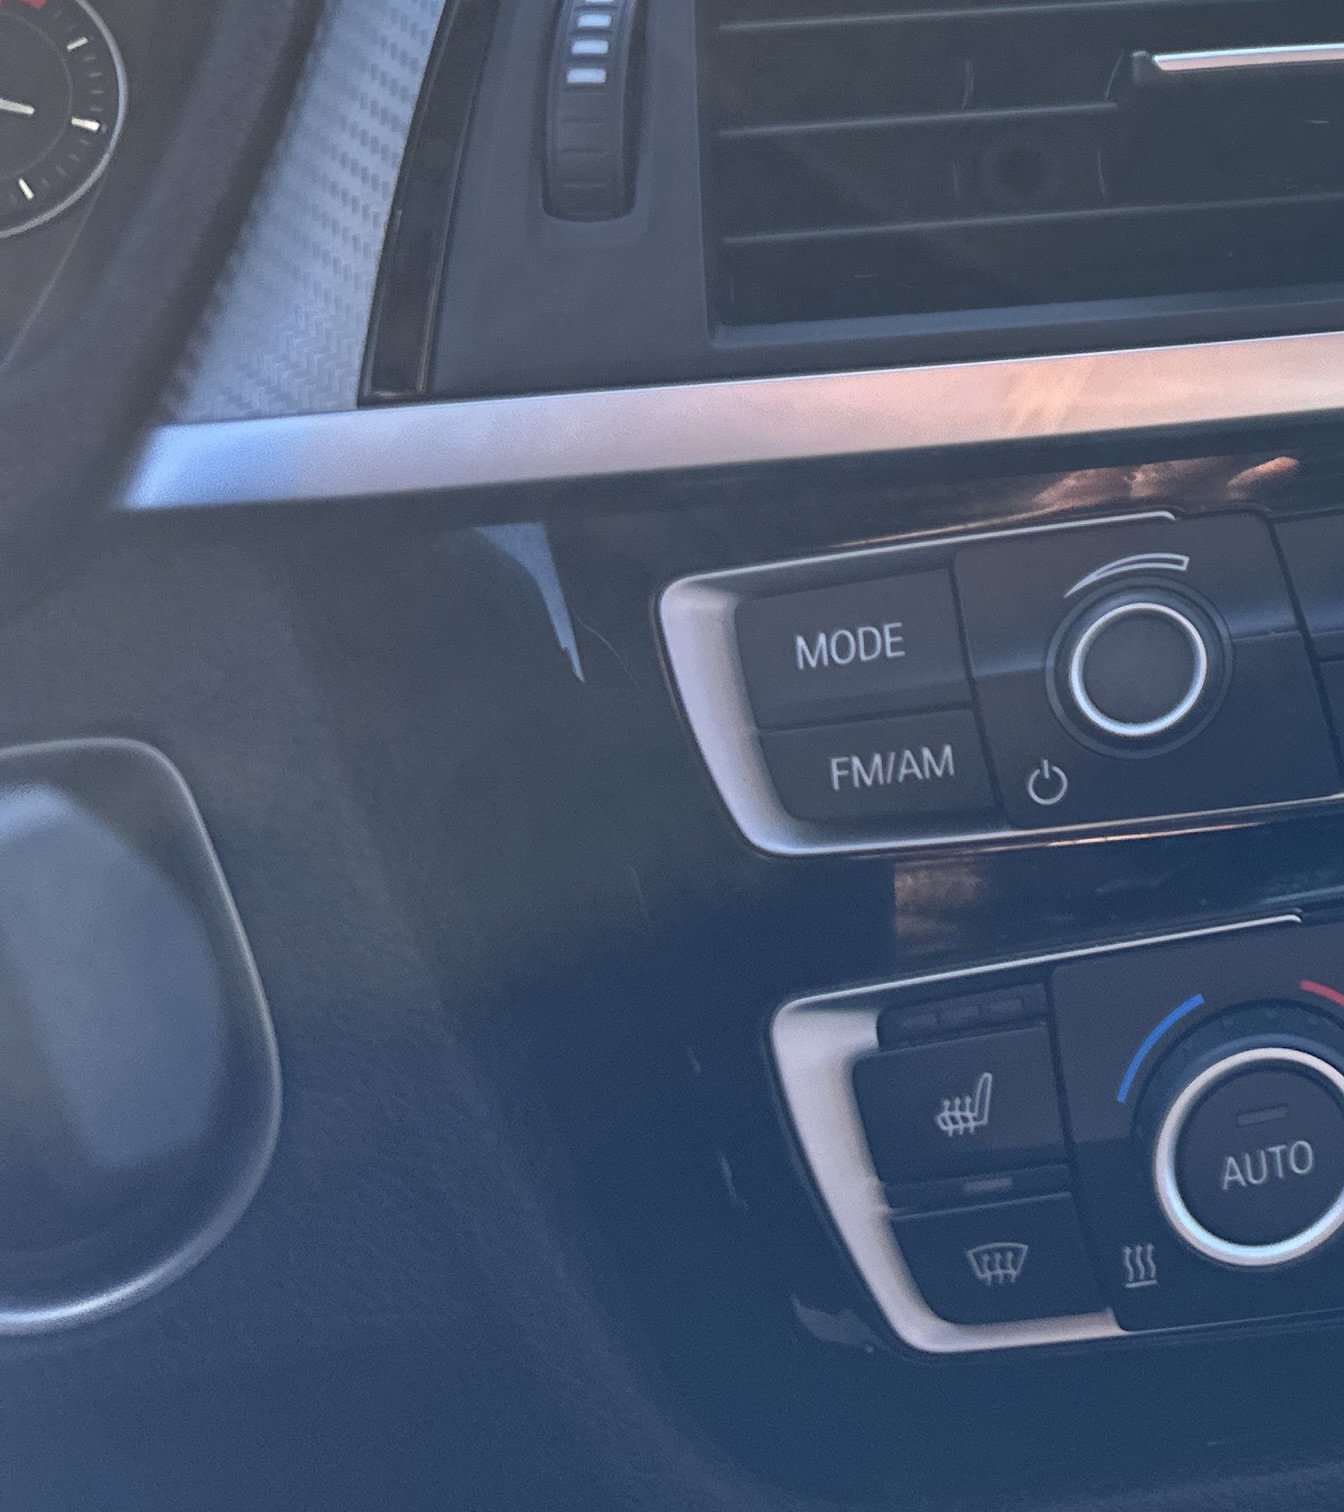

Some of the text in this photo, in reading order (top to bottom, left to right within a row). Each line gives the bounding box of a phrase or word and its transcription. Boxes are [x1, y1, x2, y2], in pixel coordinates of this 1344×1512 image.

[795, 622, 905, 670] MODE
[831, 745, 955, 792] FM/AM
[1221, 1140, 1315, 1190] AUTO
